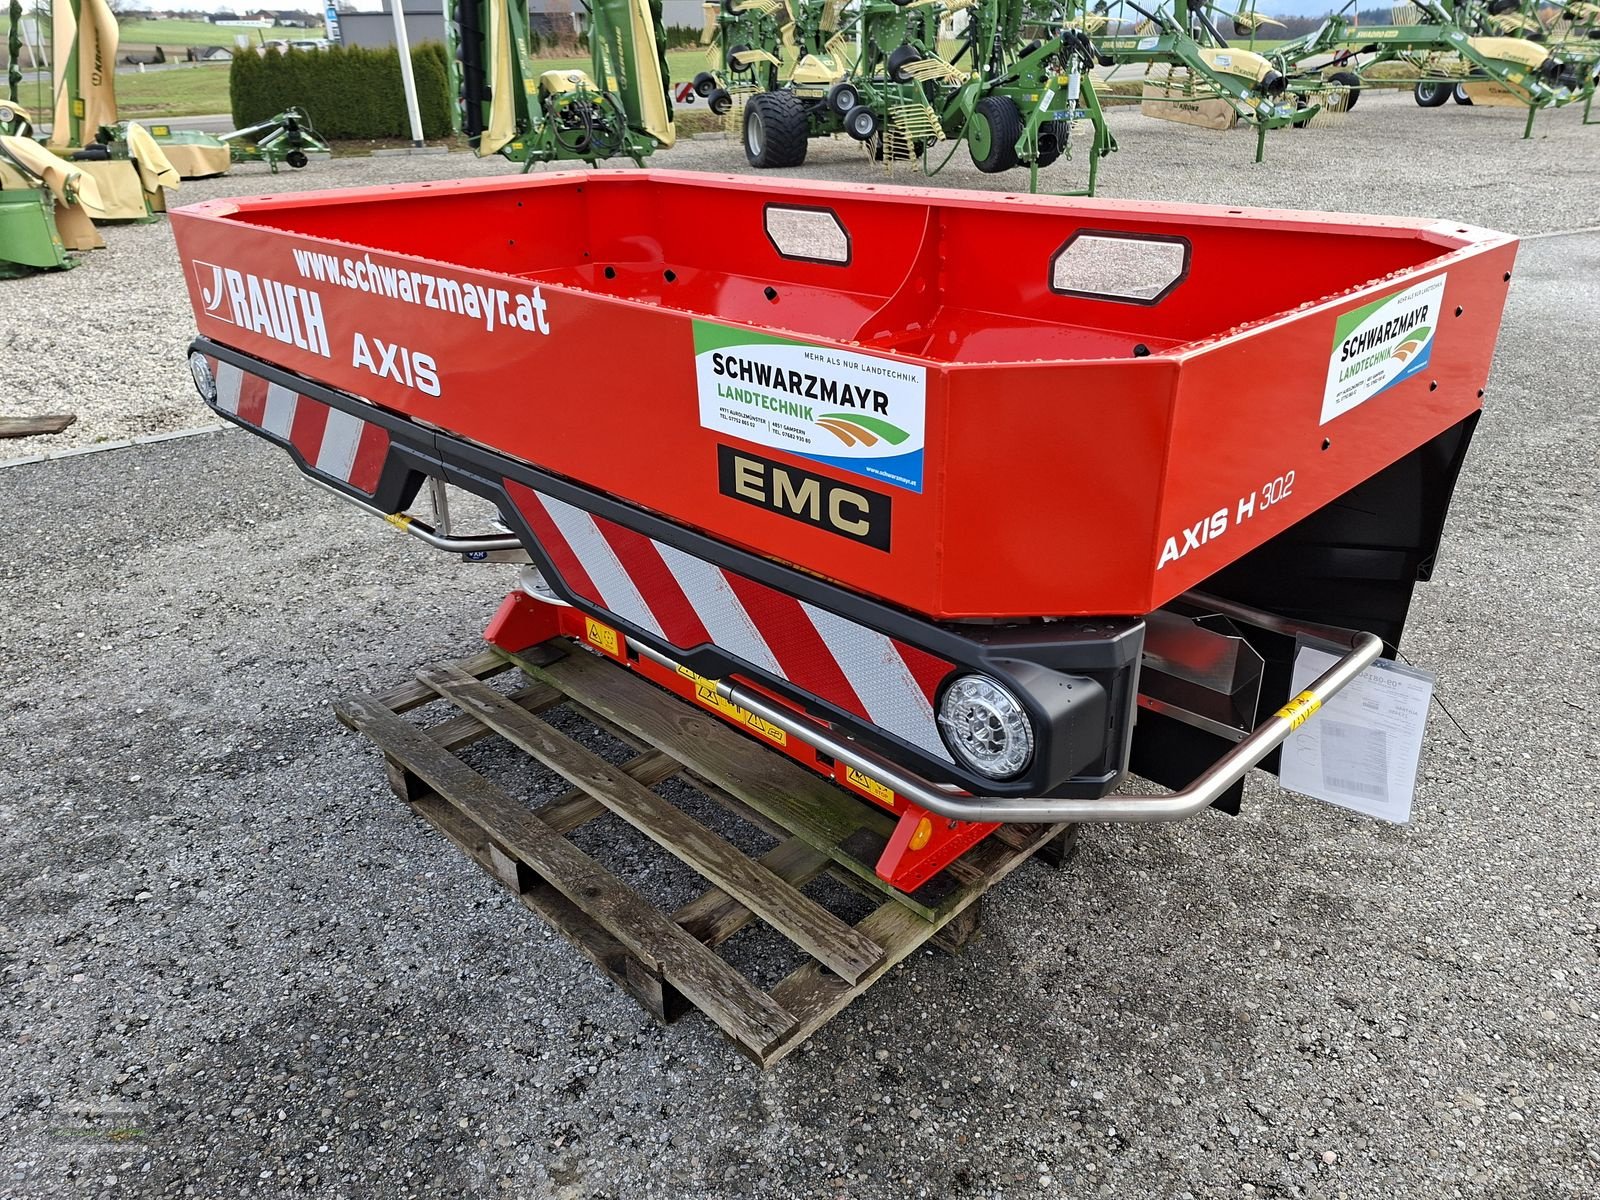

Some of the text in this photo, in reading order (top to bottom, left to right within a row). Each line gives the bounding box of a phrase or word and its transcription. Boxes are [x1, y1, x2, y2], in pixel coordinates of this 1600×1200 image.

[225, 268, 331, 358] RAUCH
[292, 248, 549, 335] www.schwarzmayr.at
[1340, 305, 1429, 362] SCHWARZMAYR
[352, 332, 441, 397] AXIS
[712, 352, 889, 416] SCHWARZMAYR
[804, 352, 919, 384] MEHR ALS NUR LANDTECHNIK.
[1338, 346, 1393, 383] LANDTECHNIK
[717, 383, 814, 421] LANDTECHNIK
[783, 424, 806, 435] GAMPERN
[734, 455, 870, 537] EMC
[1156, 470, 1295, 570] AXIS H 30.2
[875, 788, 889, 799] STOP
